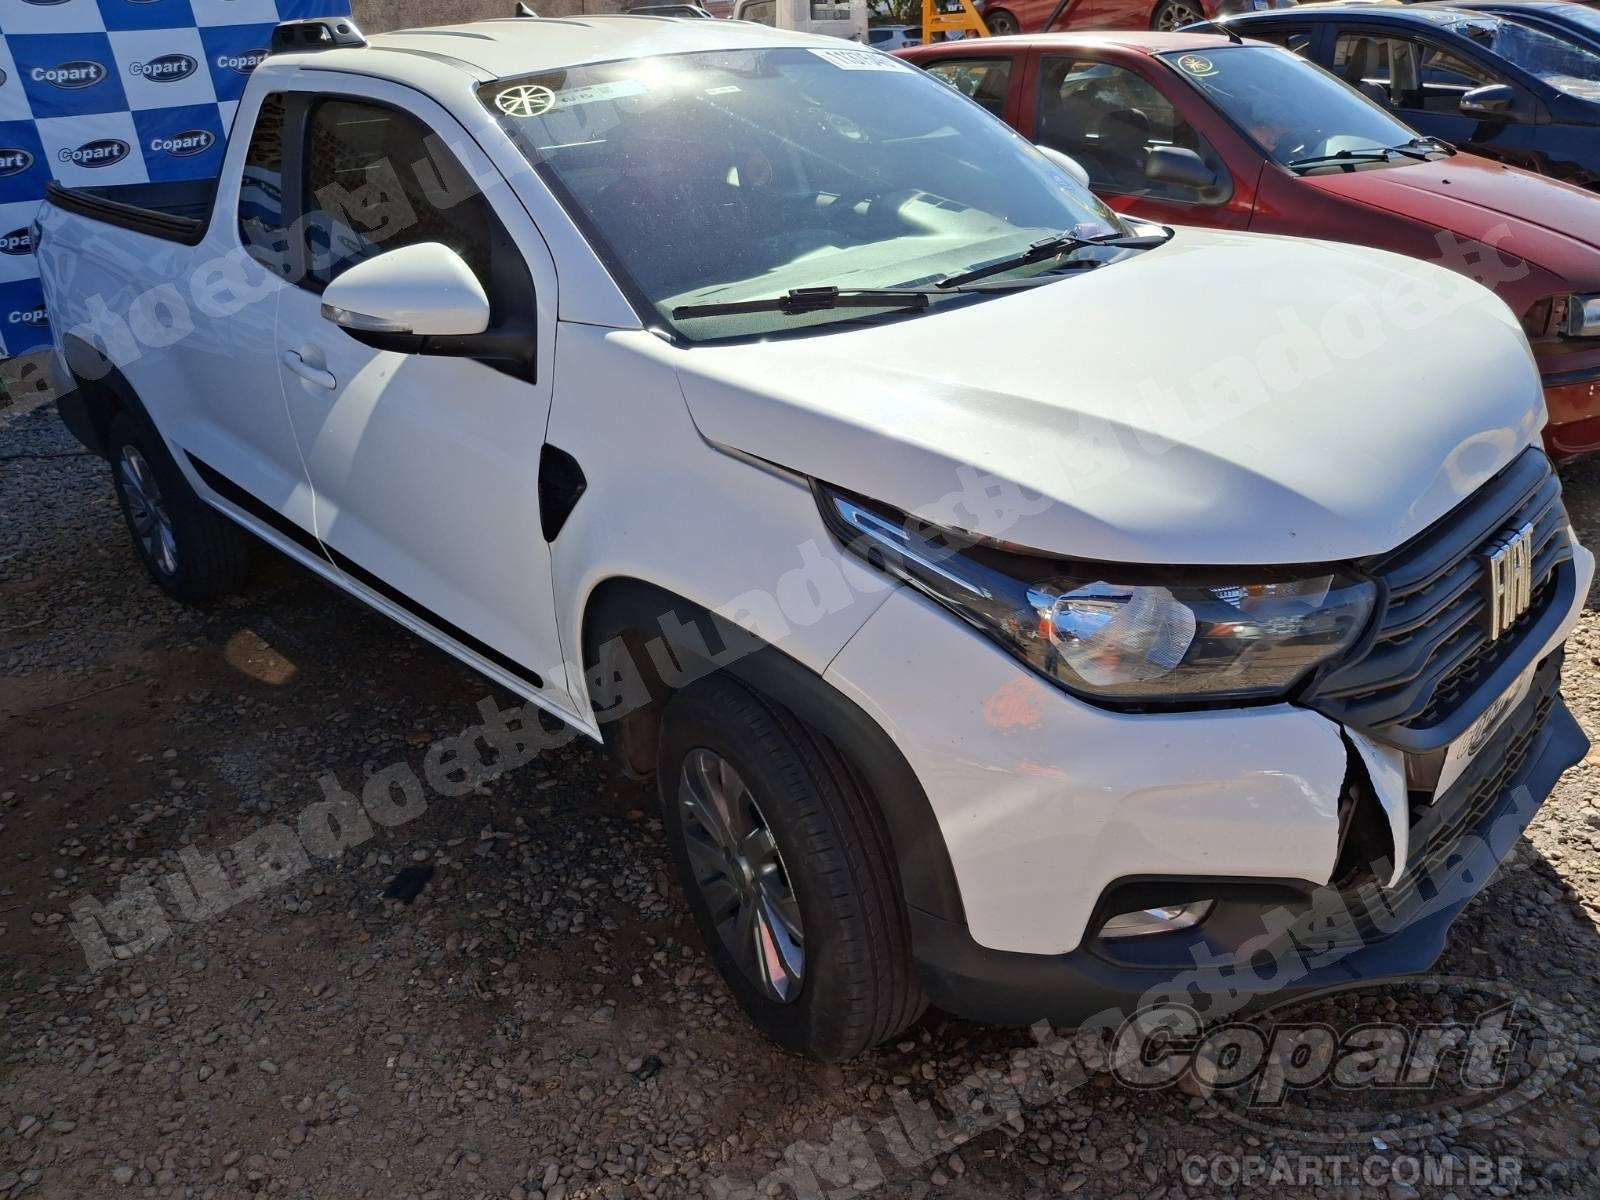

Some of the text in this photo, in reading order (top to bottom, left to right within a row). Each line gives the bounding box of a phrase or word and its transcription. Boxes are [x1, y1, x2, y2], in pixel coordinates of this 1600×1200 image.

[31, 66, 97, 82] Copart
[128, 59, 188, 77] Copart
[151, 134, 207, 151] Copart
[58, 143, 120, 162] Copart
